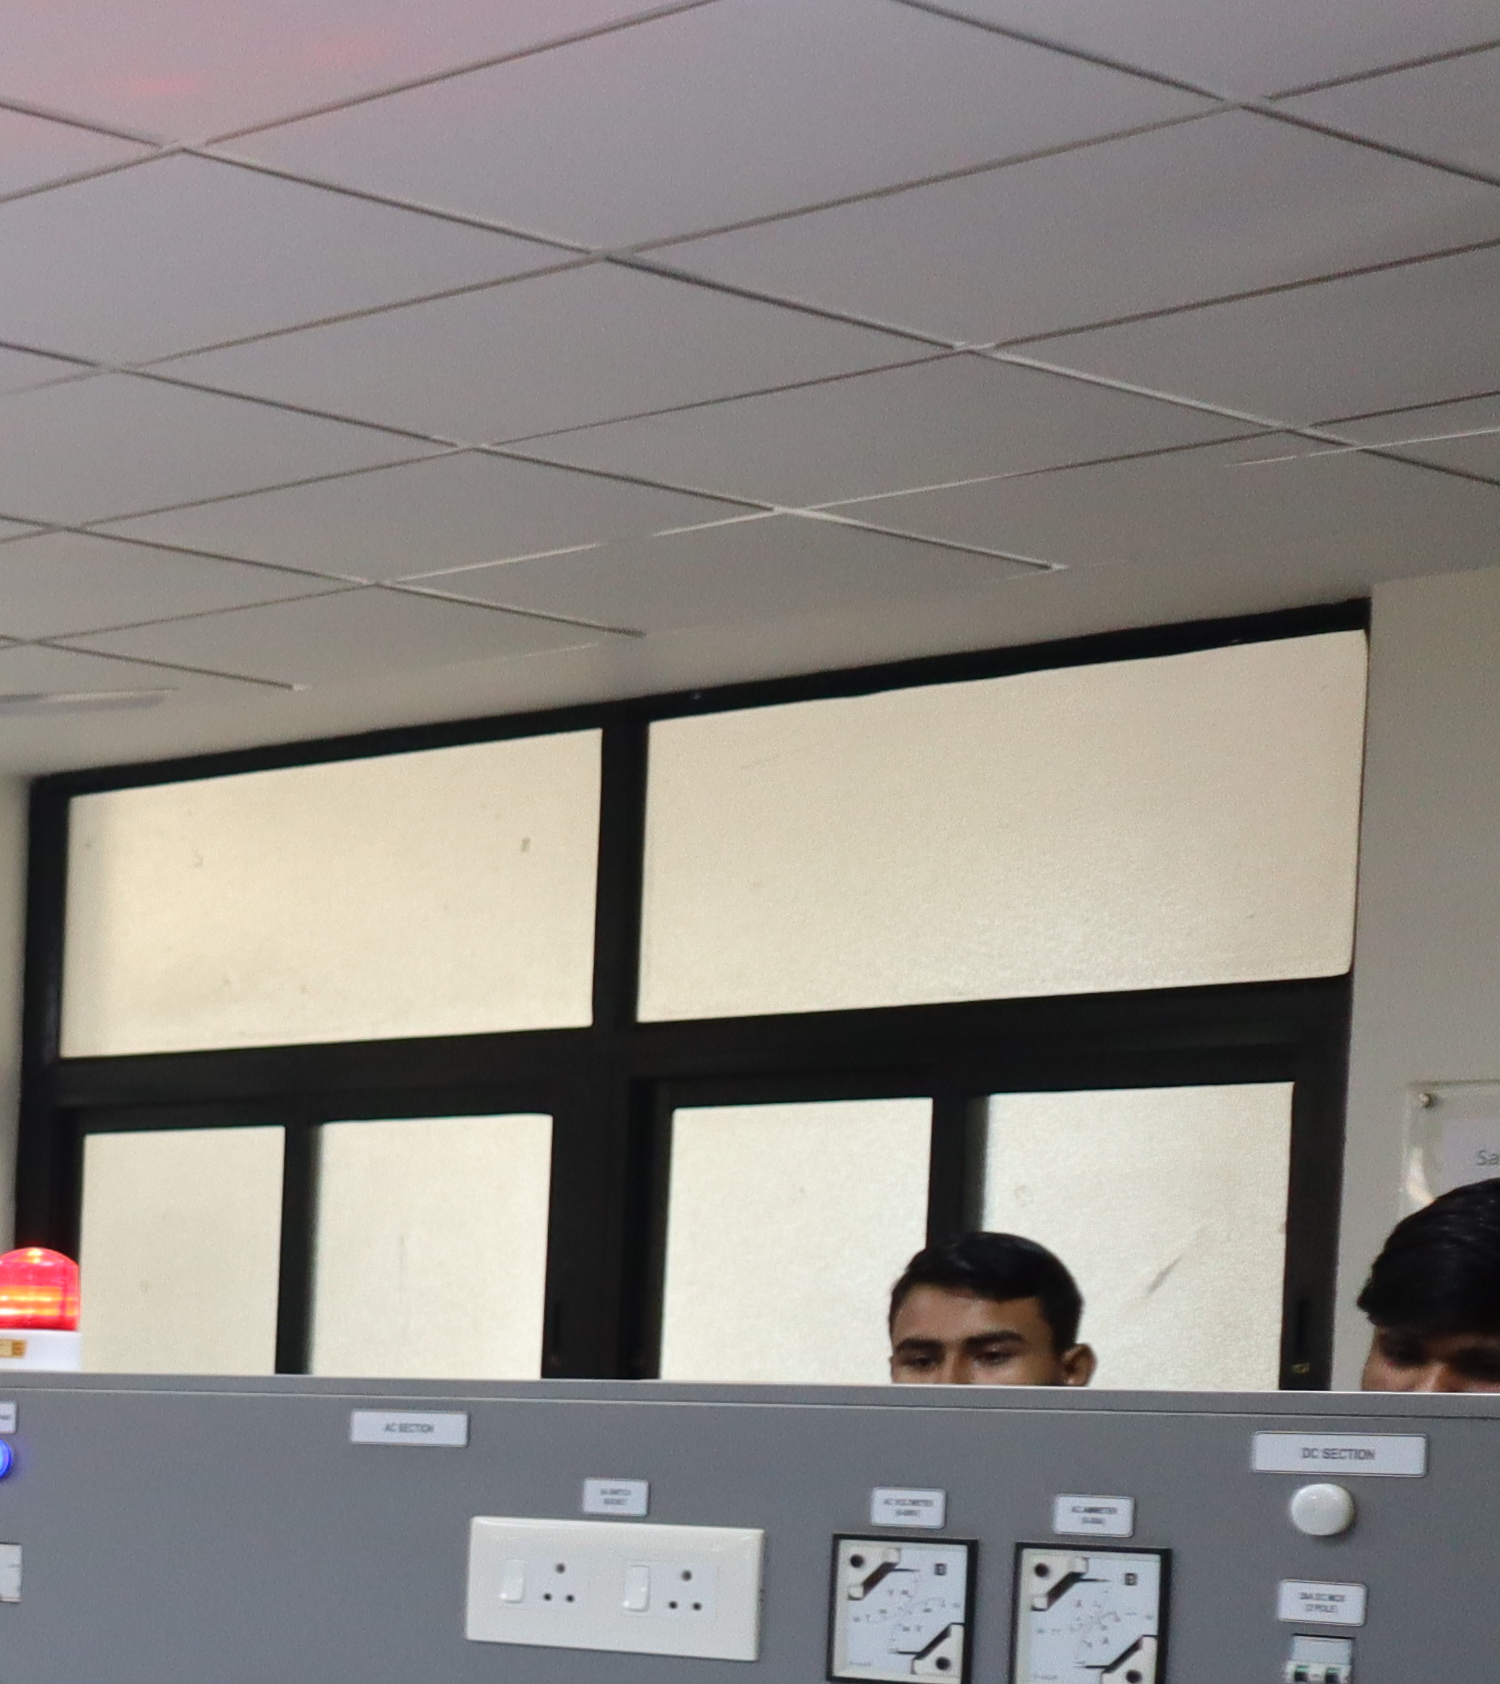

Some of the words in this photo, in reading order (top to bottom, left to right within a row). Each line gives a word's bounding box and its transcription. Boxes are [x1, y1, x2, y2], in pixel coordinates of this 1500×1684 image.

[398, 1423, 435, 1434] SECTION
[1301, 1447, 1320, 1460] DC
[1321, 1448, 1376, 1461] SECTION
